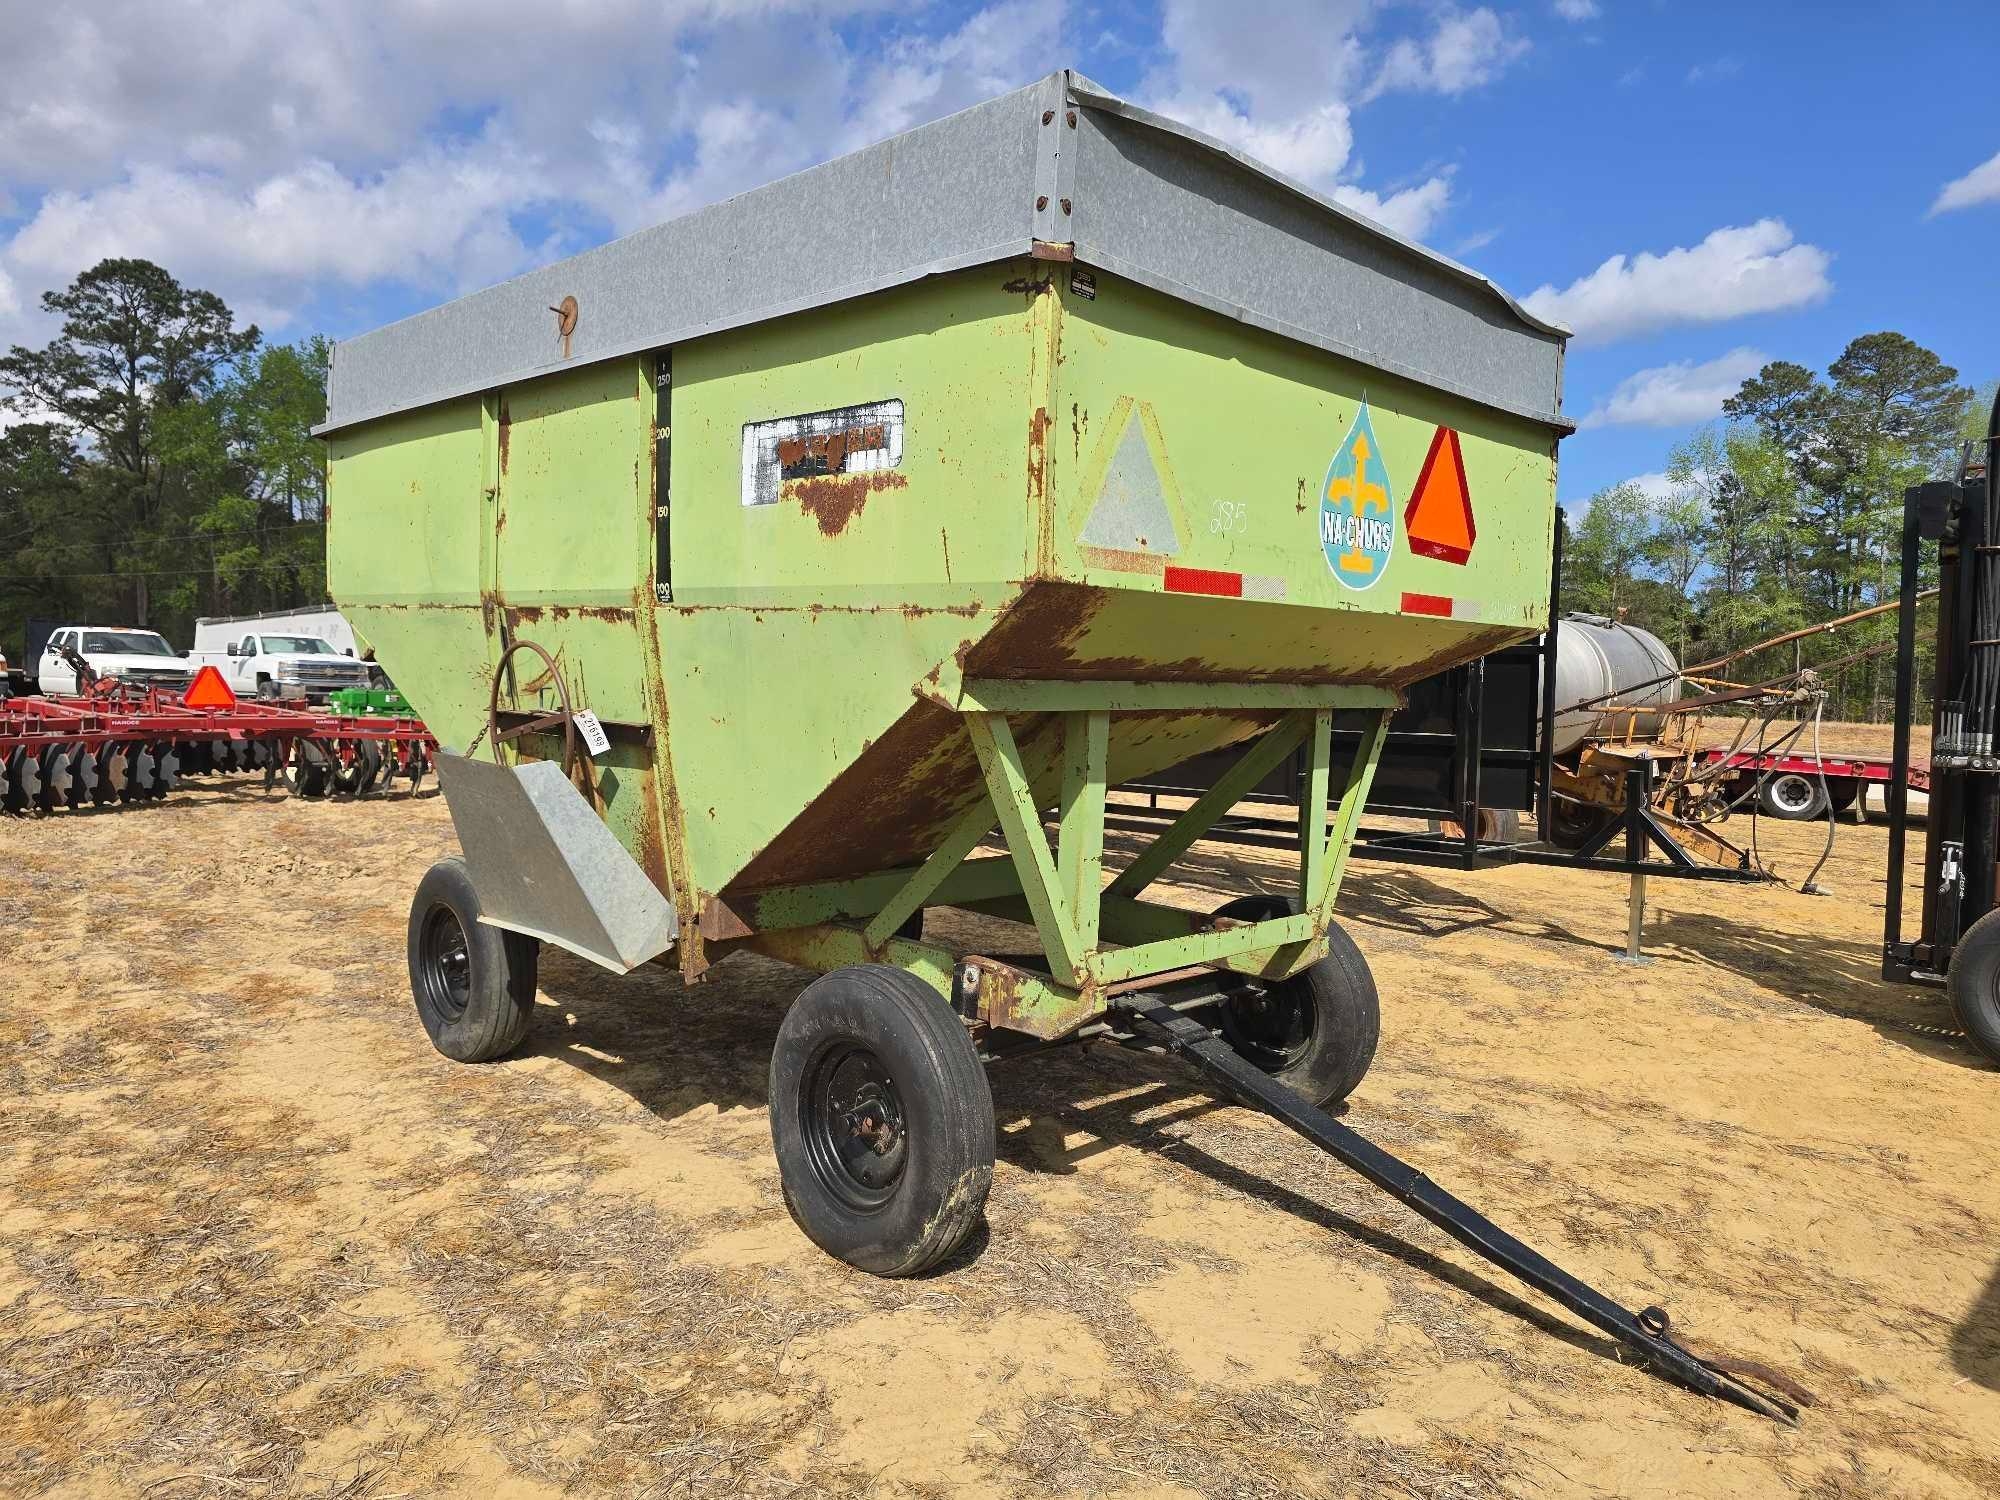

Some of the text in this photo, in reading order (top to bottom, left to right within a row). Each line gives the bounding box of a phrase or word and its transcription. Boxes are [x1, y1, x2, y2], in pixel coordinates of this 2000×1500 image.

[657, 373, 671, 387] 250
[656, 426, 671, 440] 200
[657, 505, 669, 518] 150
[1210, 499, 1247, 534] 285
[656, 582, 670, 596] 100
